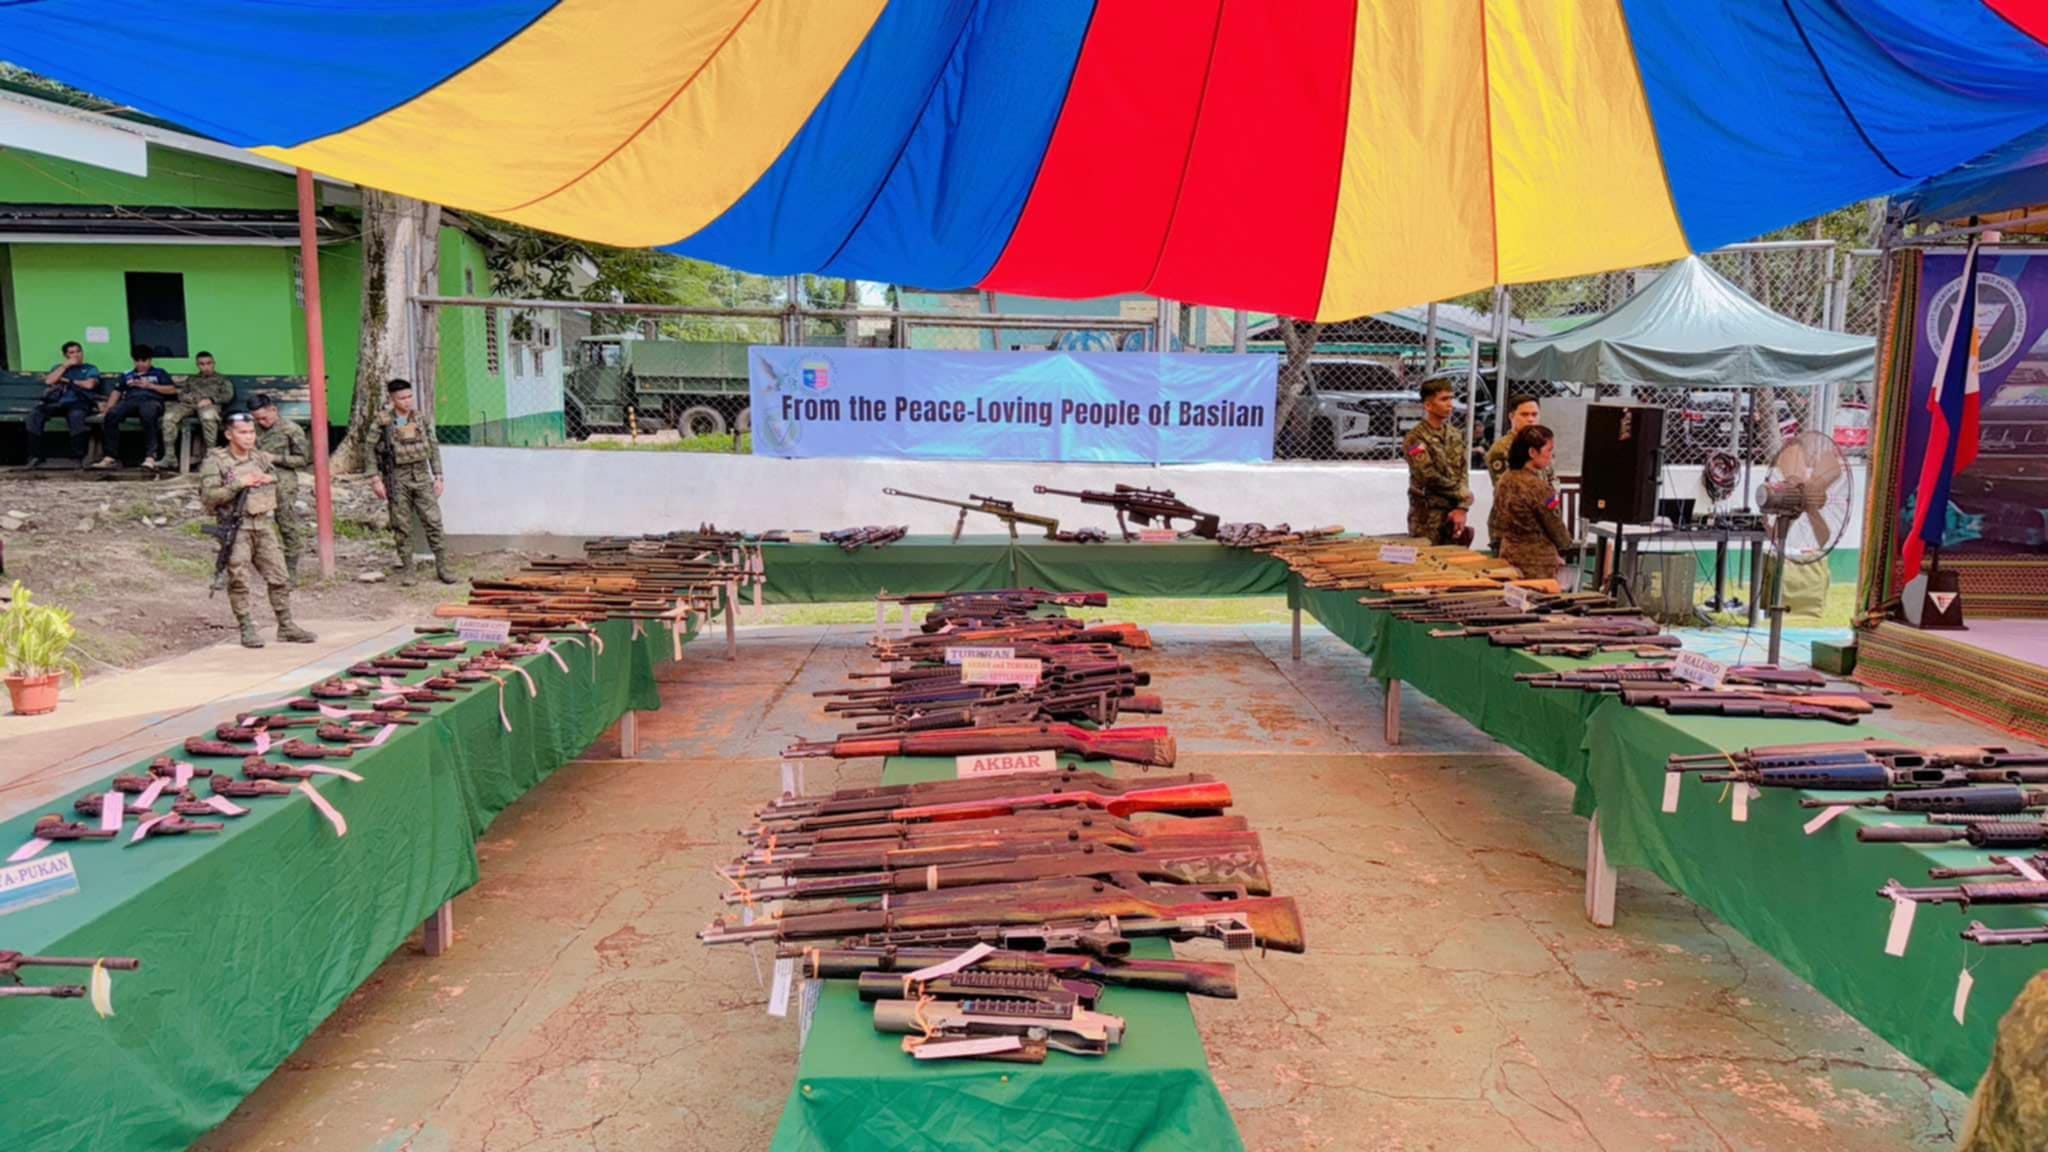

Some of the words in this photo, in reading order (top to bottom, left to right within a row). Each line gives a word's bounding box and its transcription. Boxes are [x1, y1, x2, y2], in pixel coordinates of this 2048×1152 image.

[782, 394, 841, 421] From
[849, 395, 887, 422] the
[895, 396, 1052, 427] Peace-Loving
[1061, 399, 1140, 428] People
[1148, 400, 1171, 426] of
[1179, 399, 1264, 427] Basilan
[1683, 654, 1720, 674] MALUSO
[973, 755, 1041, 773] AKBAR
[0, 856, 69, 888] A-PUKAN
